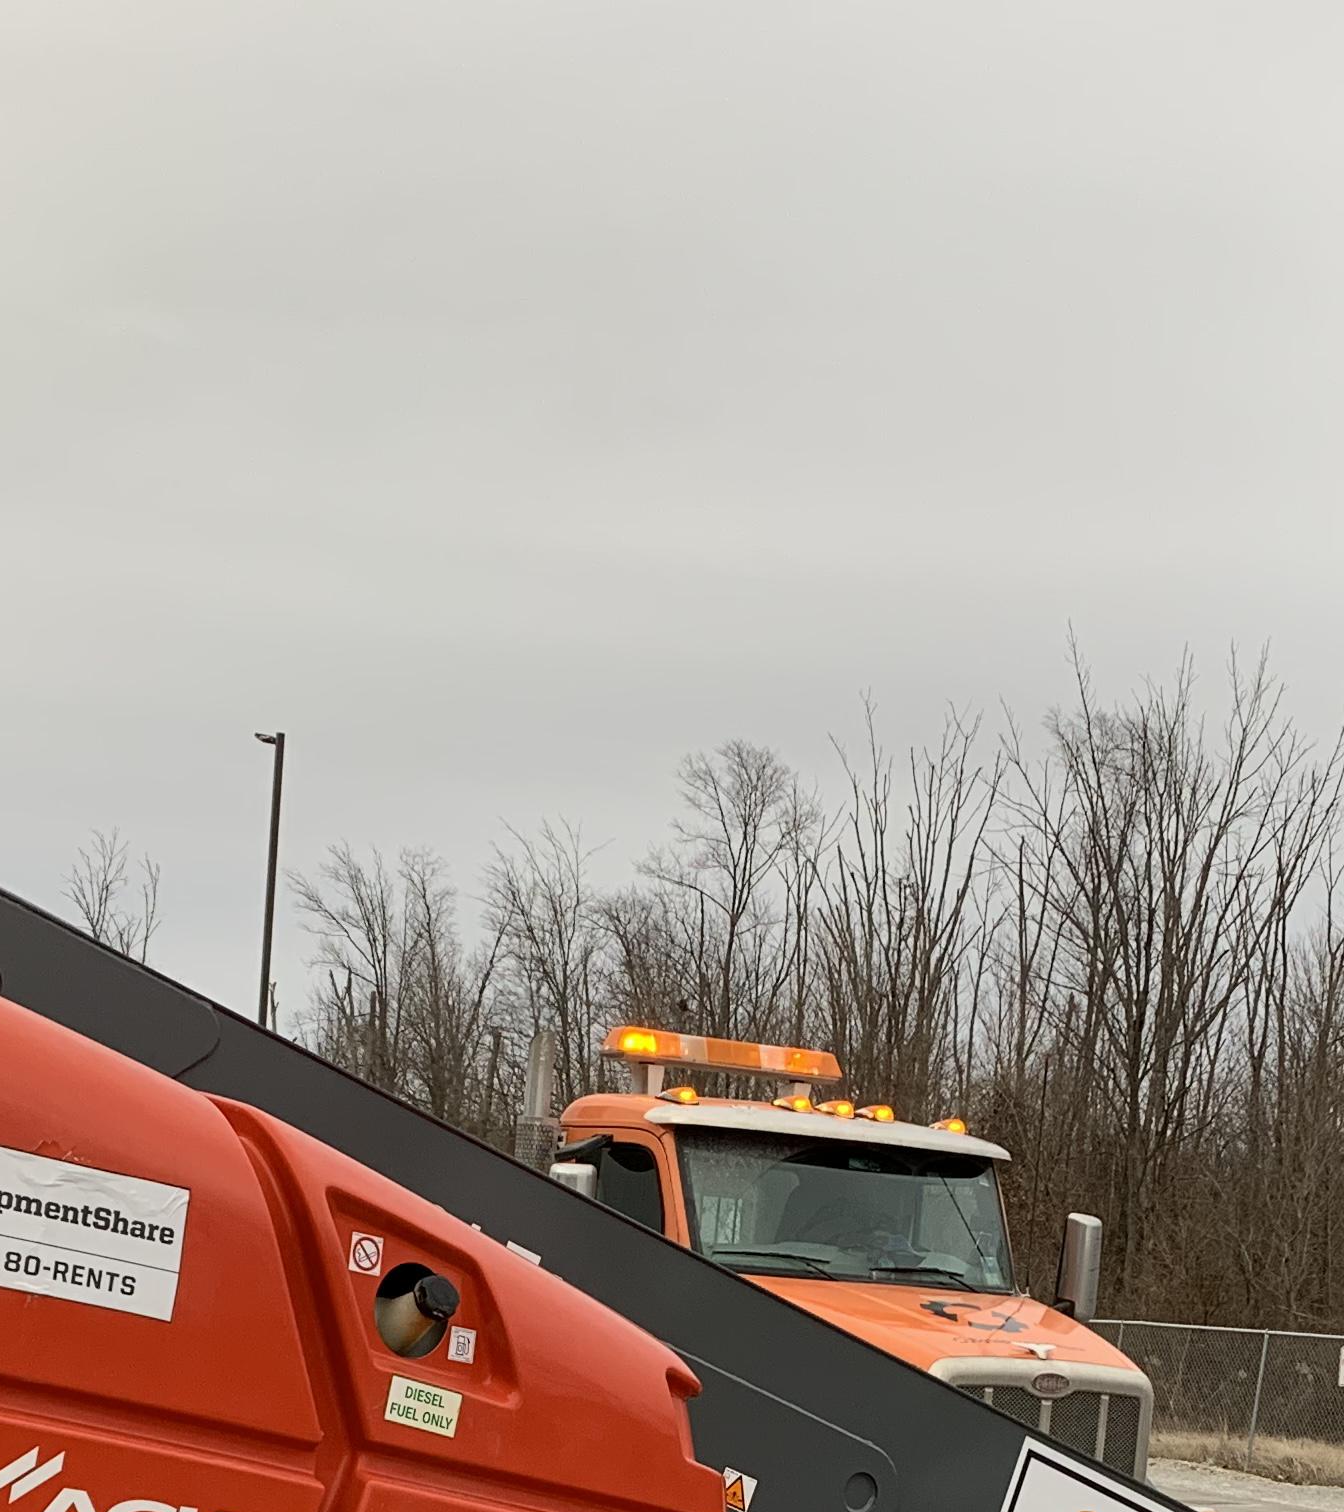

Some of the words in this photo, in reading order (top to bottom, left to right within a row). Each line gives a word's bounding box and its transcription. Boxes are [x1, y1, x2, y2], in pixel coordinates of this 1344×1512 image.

[4, 1249, 137, 1297] 80-RENTS
[404, 1385, 445, 1409] DIESEL
[389, 1401, 419, 1422] FUEL
[422, 1411, 454, 1431] ONLY
